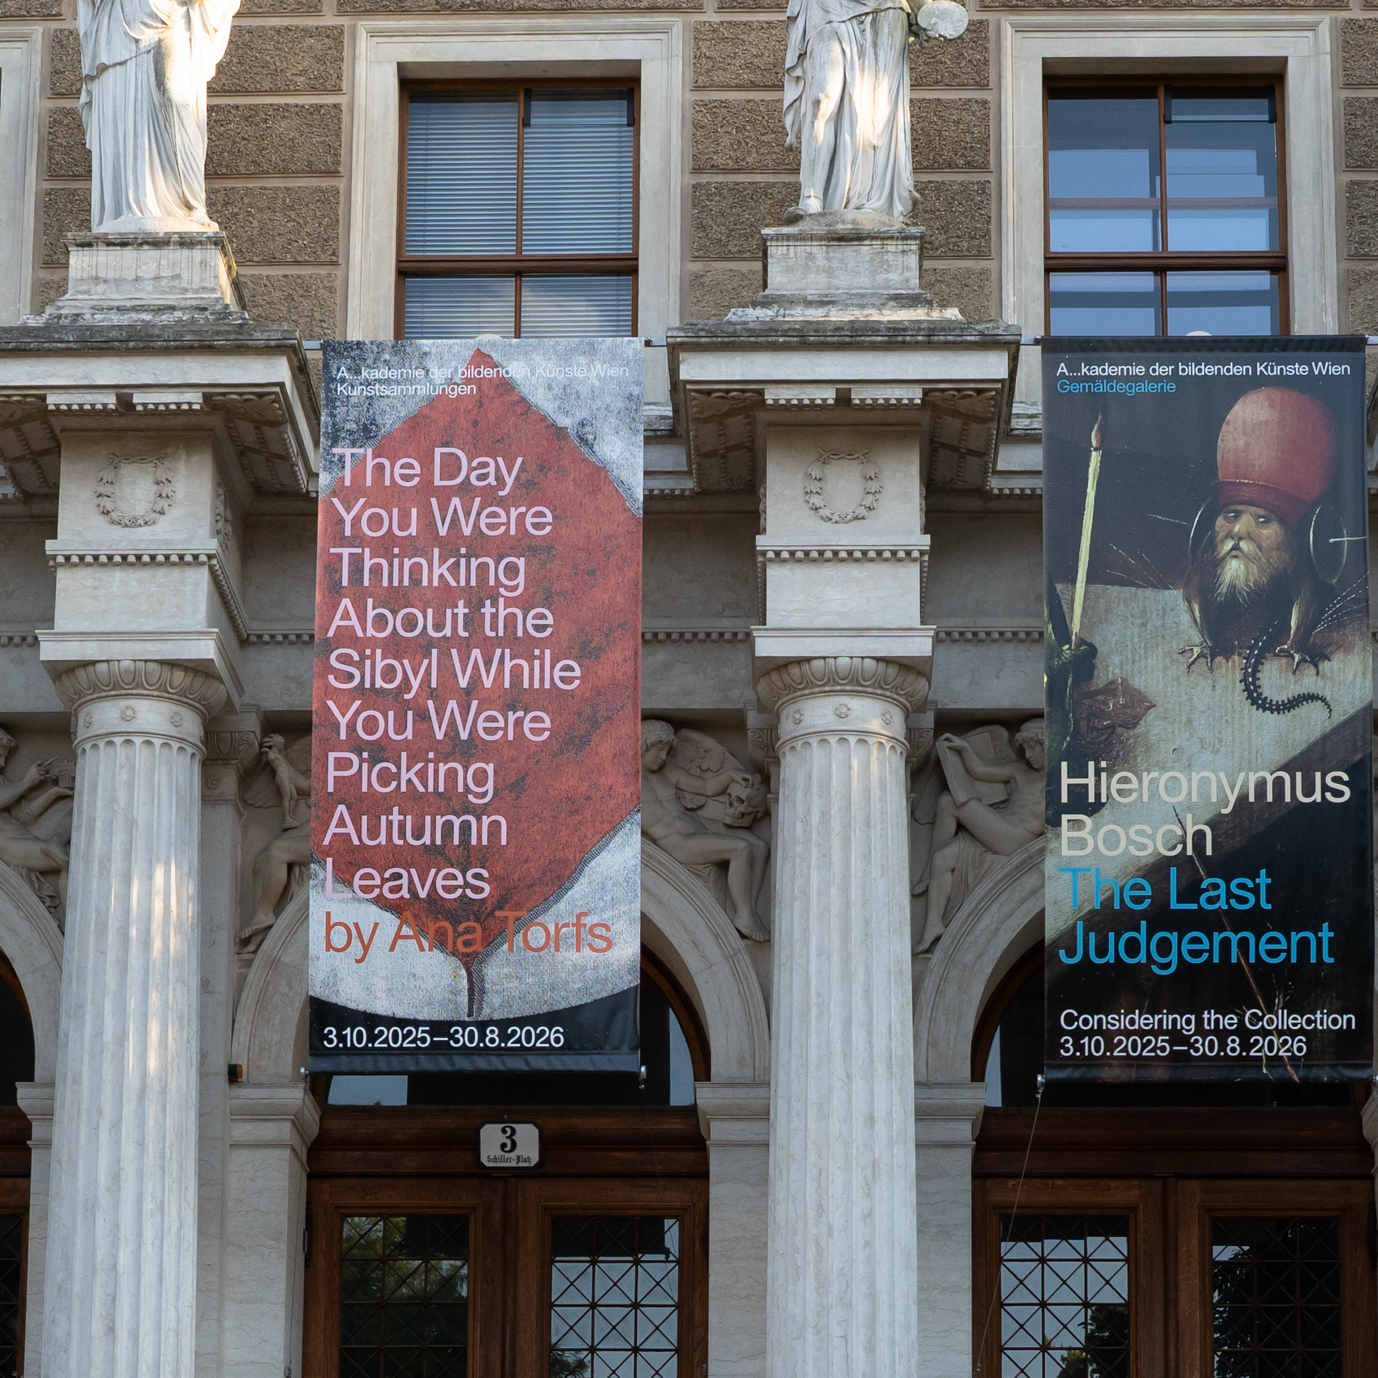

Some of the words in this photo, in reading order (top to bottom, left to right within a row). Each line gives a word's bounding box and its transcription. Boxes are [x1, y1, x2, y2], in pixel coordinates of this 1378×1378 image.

[336, 382, 476, 398] Kunstsammlungen
[429, 366, 453, 379] der
[458, 365, 531, 378] bildenden
[536, 364, 588, 378] Künste
[591, 364, 629, 377] Wien
[1057, 380, 1176, 396] Gemäldegalerie
[1149, 363, 1174, 376] der
[1178, 362, 1252, 376] bildenden
[1256, 362, 1309, 376] Künste
[1312, 362, 1350, 375] Wien
[332, 448, 421, 487] The
[434, 447, 523, 496] Day
[331, 498, 417, 537] You
[430, 497, 553, 536] Were
[330, 548, 526, 598] Thinking
[327, 598, 469, 638] About
[481, 598, 554, 638] the
[328, 648, 438, 699] Sibyl
[450, 648, 581, 689] While
[326, 700, 413, 741] You
[427, 699, 551, 741] Were
[327, 752, 494, 804] Picking
[1060, 761, 1351, 813] Hieronymus
[322, 804, 507, 846] Autumn
[1060, 814, 1212, 856] Bosch
[326, 857, 491, 899] Leaves
[1059, 867, 1151, 910] The
[1170, 867, 1272, 910] Last
[325, 911, 379, 964] by
[389, 912, 482, 952] Ana
[495, 911, 613, 953] Torfs
[1059, 921, 1334, 975] Judgement
[1060, 1009, 1195, 1034] Considering
[1203, 1010, 1238, 1030] the
[1244, 1009, 1355, 1030] Collection
[500, 1125, 517, 1153] 3
